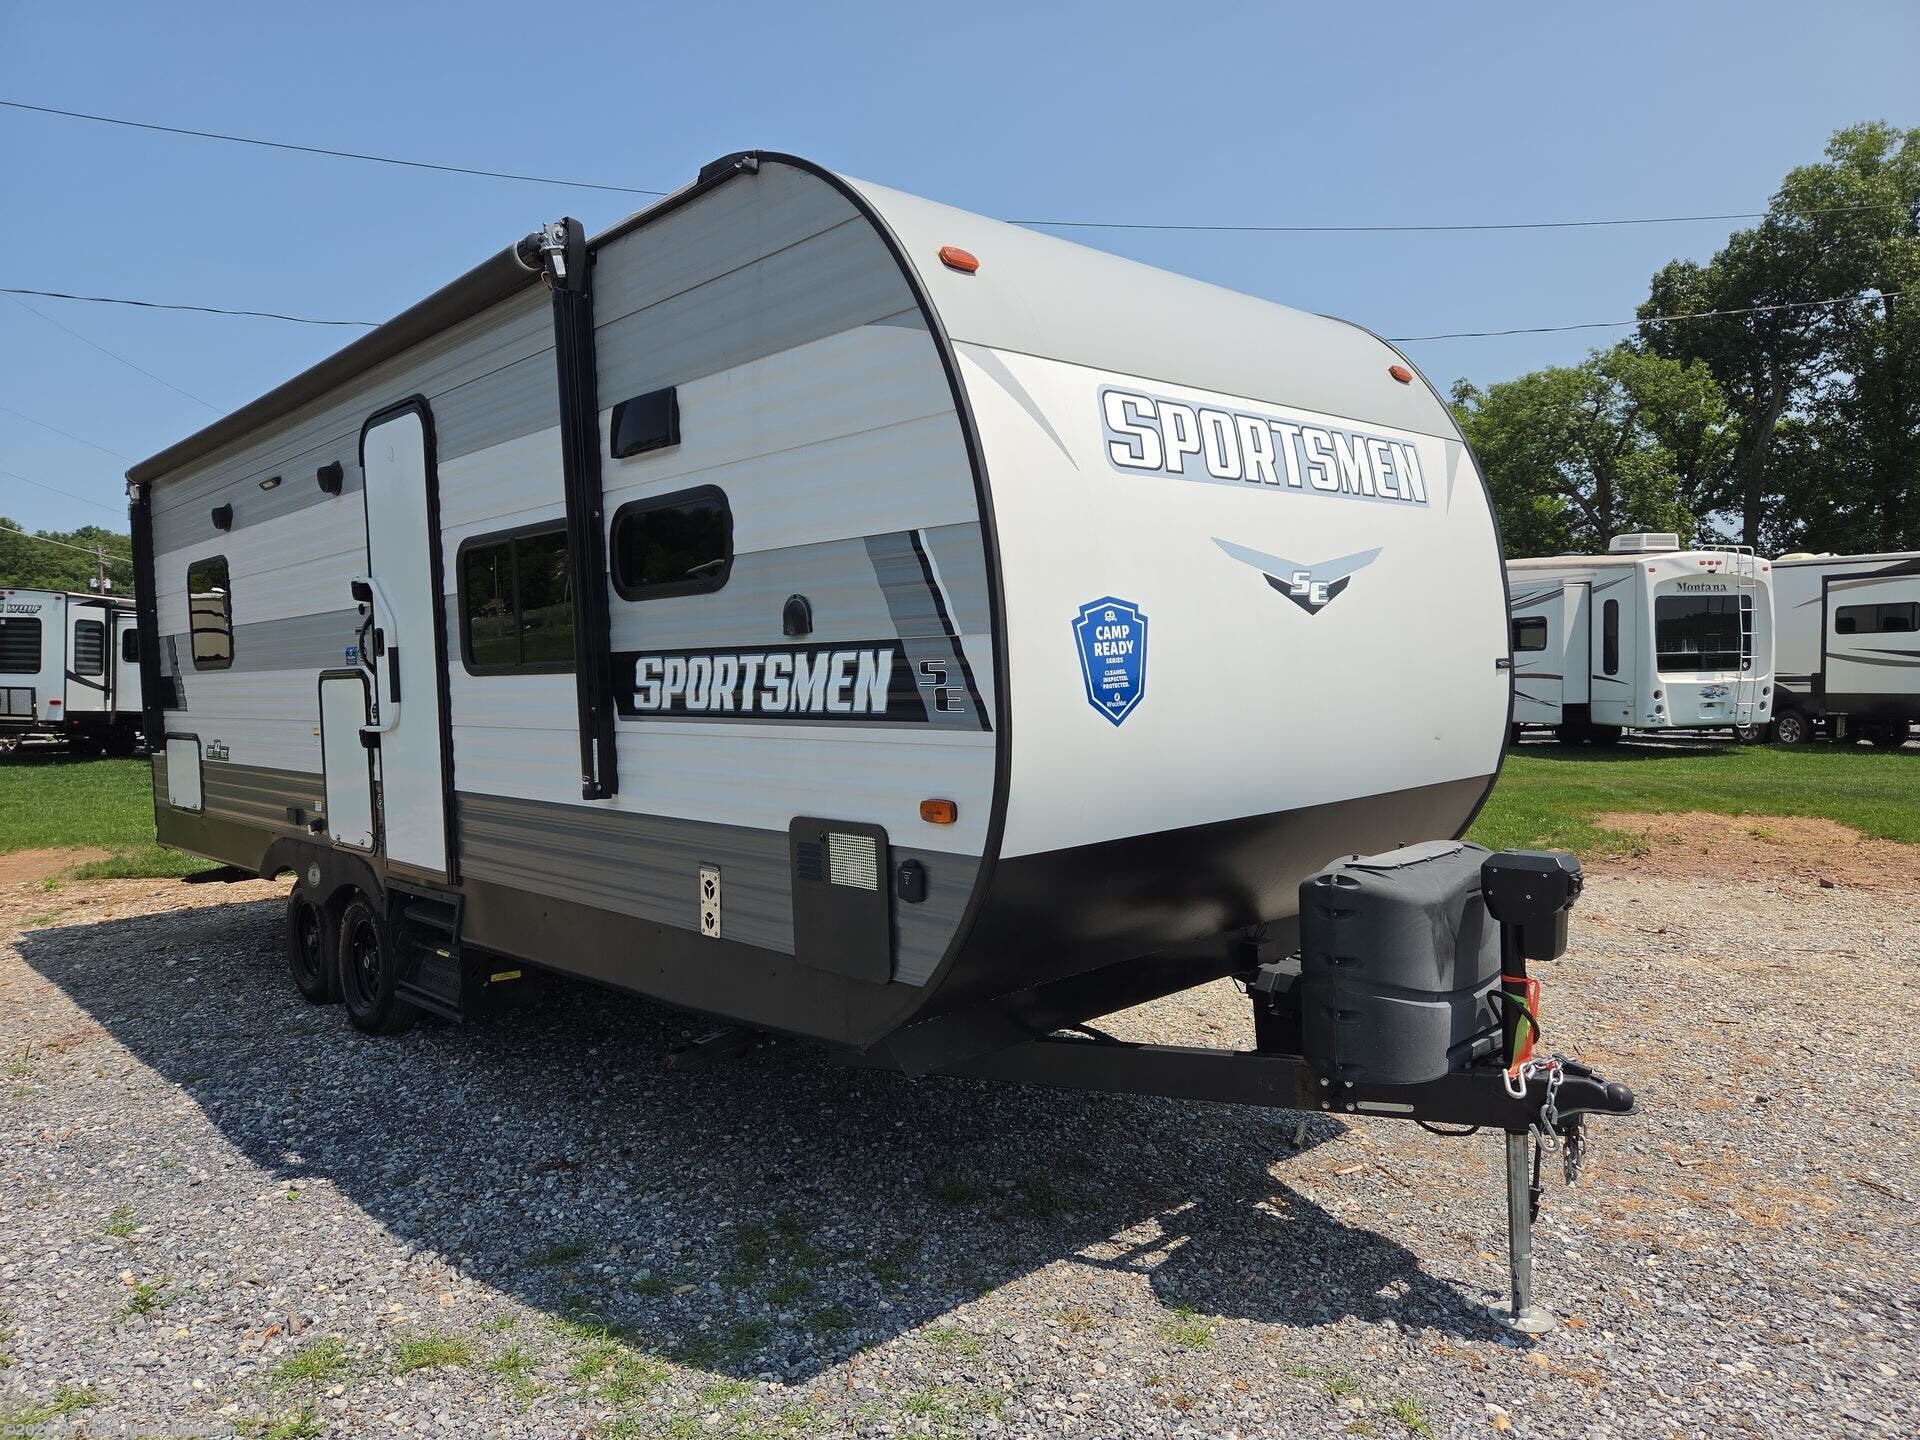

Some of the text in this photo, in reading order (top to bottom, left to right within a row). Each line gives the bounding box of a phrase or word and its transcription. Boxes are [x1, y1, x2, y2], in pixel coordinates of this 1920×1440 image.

[1102, 389, 1428, 504] SPORTSMEN
[1290, 570, 1330, 605] SE
[1676, 582, 1728, 593] Montana
[1096, 625, 1130, 641] CAMP
[1094, 640, 1134, 656] READY
[633, 648, 965, 714] SPORTSMEN SE
